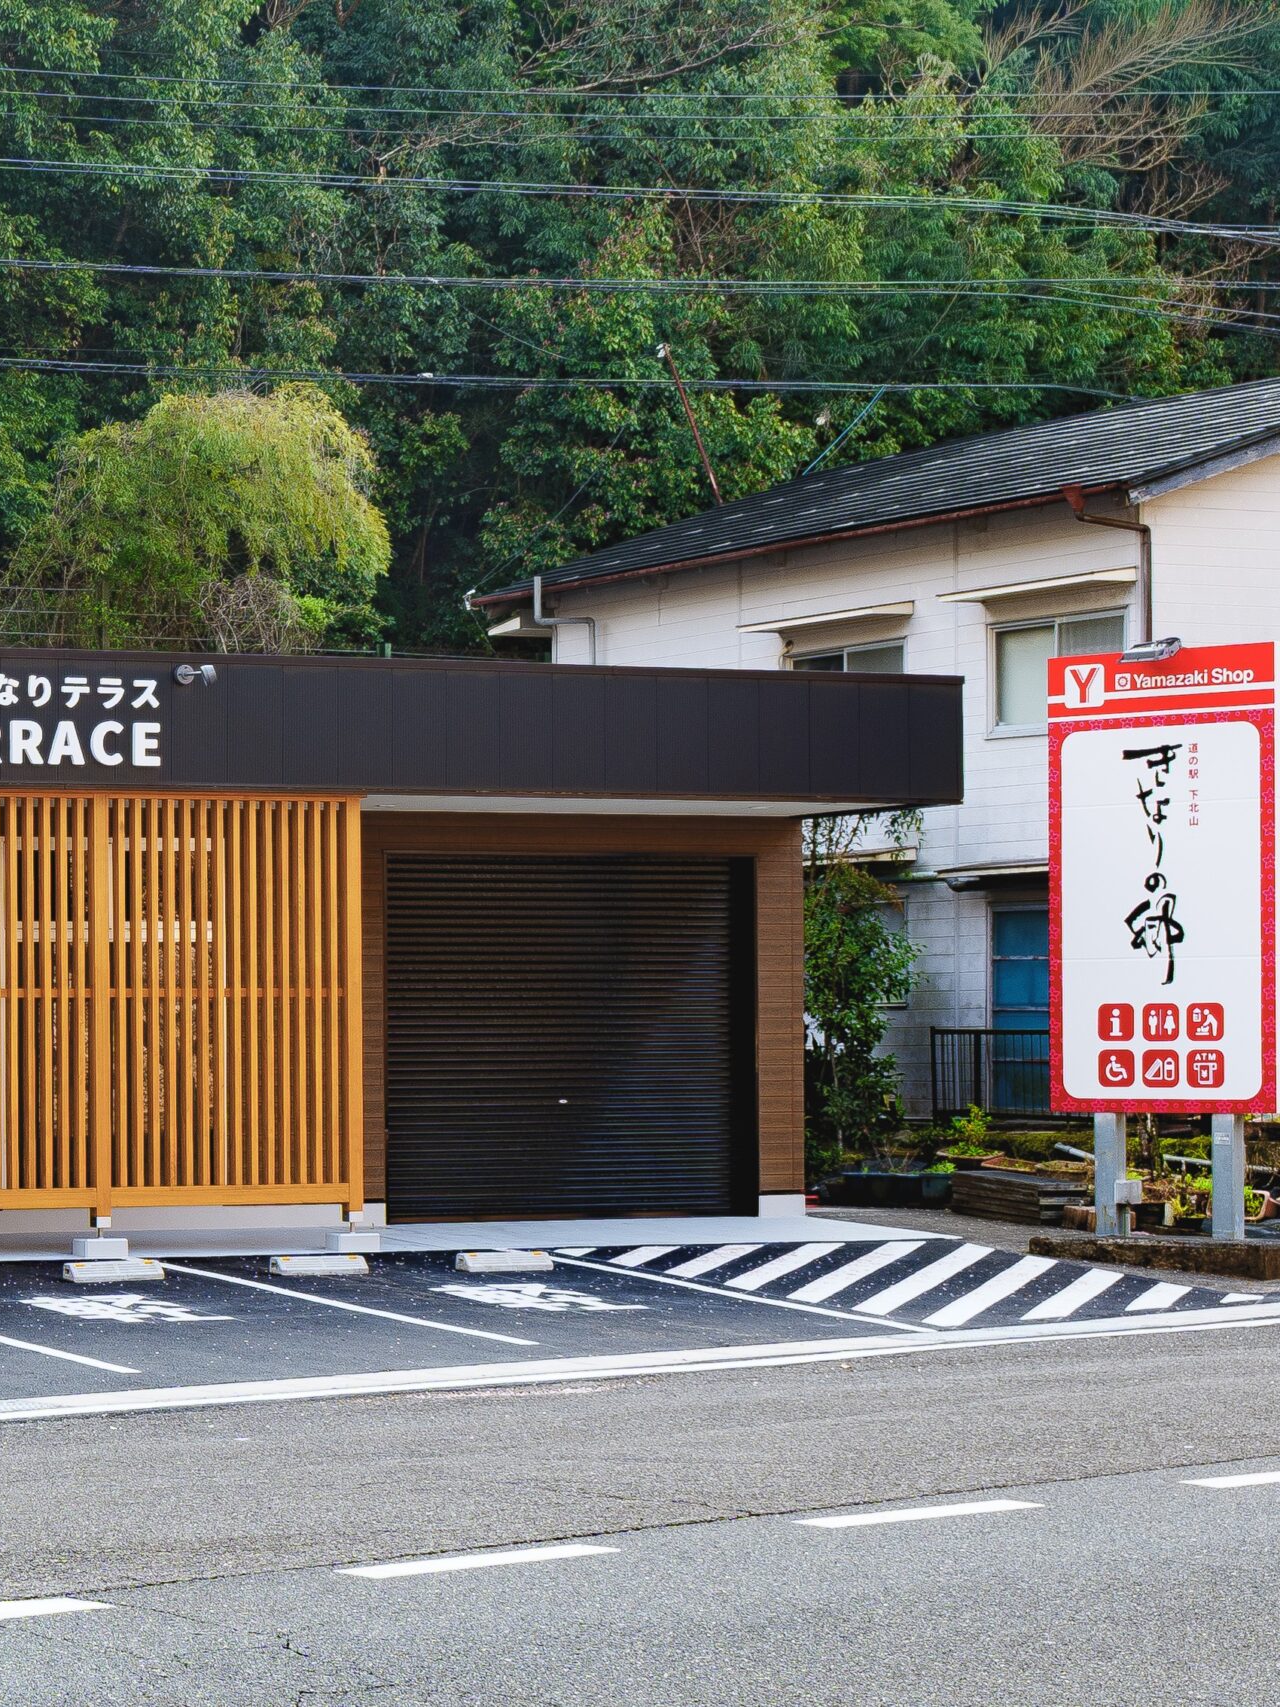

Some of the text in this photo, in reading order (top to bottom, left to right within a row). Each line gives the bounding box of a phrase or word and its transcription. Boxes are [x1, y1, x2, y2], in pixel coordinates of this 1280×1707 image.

[1133, 668, 1254, 689] Yamazaki Shop
[1188, 743, 1199, 826] 道の駅 下北山
[1194, 1053, 1216, 1061] ATM
